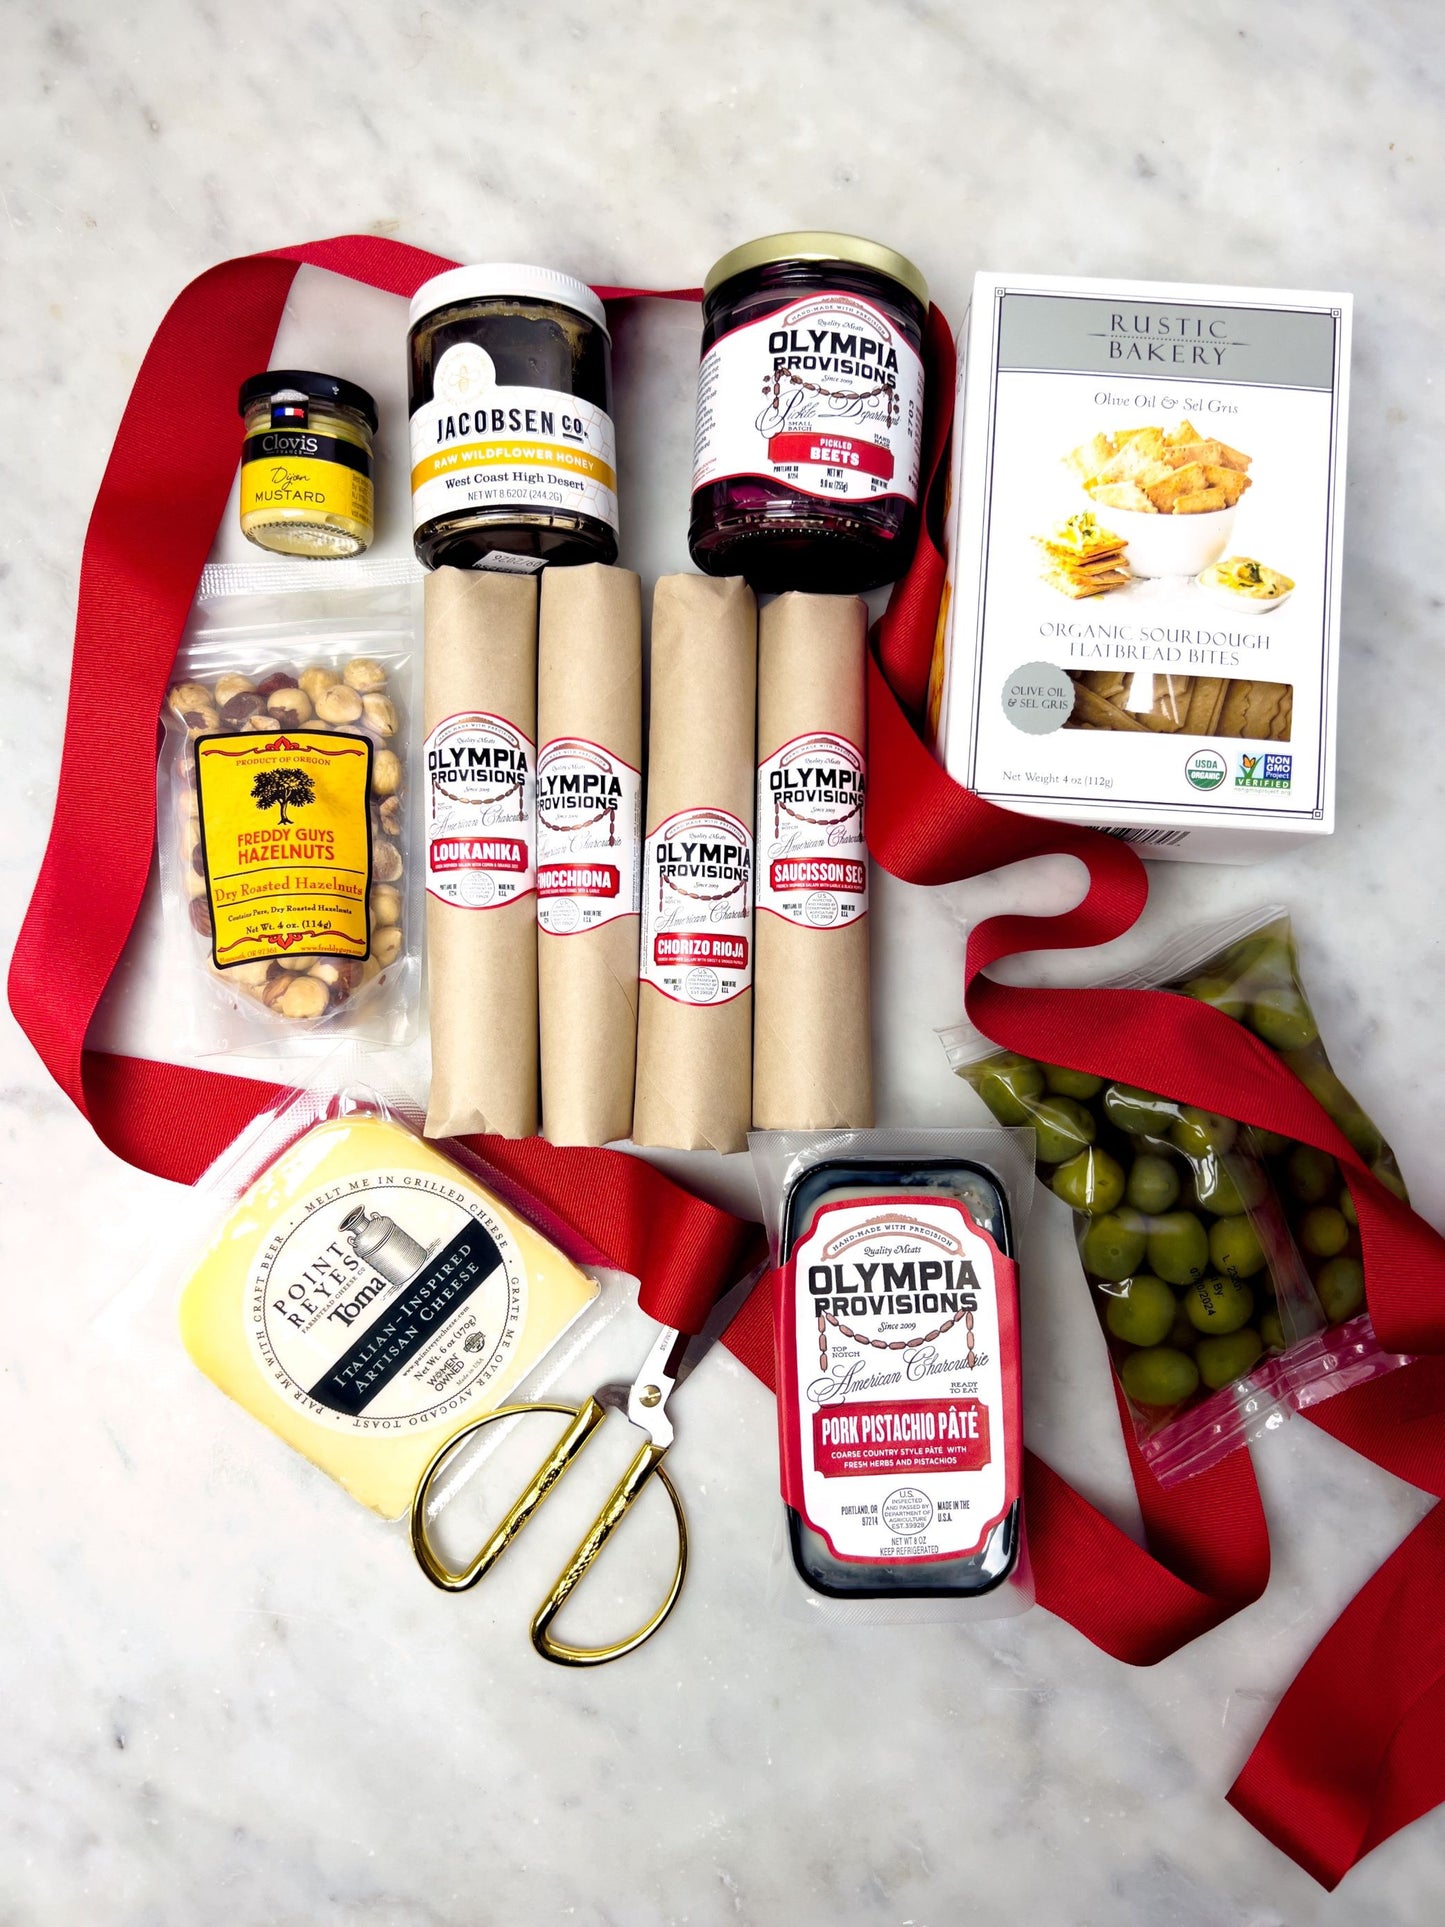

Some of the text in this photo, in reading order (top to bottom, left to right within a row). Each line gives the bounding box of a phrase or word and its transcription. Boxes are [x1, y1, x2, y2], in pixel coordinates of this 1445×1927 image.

[1110, 314, 1228, 339] RUSTIC
[768, 329, 899, 374] OLYMPIA
[1109, 341, 1227, 366] BAKERY
[773, 356, 896, 389] PROVISIONS
[818, 390, 901, 424] Departmnt
[1094, 392, 1239, 415] Olive Oil & Sel Gris
[437, 408, 588, 444] JACOBSEN CO.
[262, 435, 318, 452] Clovis
[820, 438, 853, 451] PICKLED
[434, 447, 594, 472] RAW WILDFLOWER HONEY
[810, 446, 860, 467] BEETS
[270, 466, 311, 491] Dijon
[445, 472, 585, 491] West Coast High Desert
[255, 490, 326, 504] MUSTARD
[468, 490, 482, 501] NET
[485, 490, 497, 500] WT
[1040, 622, 1270, 650] ORGANIC SOURDOUGH
[1070, 642, 1240, 667] FLATBREAD BITES
[1011, 685, 1067, 697] OLIVE OIL
[1007, 698, 1069, 711] & SEL GRIS
[236, 757, 277, 767] PRODUCT
[293, 756, 331, 766] OREGON
[428, 747, 529, 773] OLYMPIA
[1195, 760, 1218, 769] USDA
[1266, 764, 1291, 773] GMO
[1267, 756, 1290, 765] NON
[431, 769, 526, 786] PROVISIONS
[770, 767, 865, 795] OLYMPIA
[1002, 771, 1114, 788] Net Weight 4 oz (112g)
[1191, 771, 1221, 781] ORGANIC
[1238, 778, 1289, 788] VERIFIED
[774, 790, 865, 807] PROVISIONS
[238, 828, 335, 848] FREDDY GUYS
[238, 844, 335, 865] HAZELNUTS
[433, 843, 521, 862] LOUKANIKA
[656, 842, 751, 869] OLYMPIA
[659, 864, 749, 882] PROVISIONS
[774, 863, 863, 884] SAUCISSON SEC
[215, 876, 363, 902] Dry Roasted Hazelnuts
[227, 910, 252, 922] Contains
[271, 905, 285, 914] Dry
[286, 904, 316, 912] Roasted
[318, 904, 352, 915] Hazelnuts
[246, 926, 259, 934] Net
[260, 923, 275, 931] Wt.
[278, 921, 283, 929] 4
[302, 920, 332, 930] (114g)
[657, 939, 744, 958] CHORIZO RIOJA
[304, 1175, 508, 1249] MELT ME IN GRILLED CHEESE
[832, 1226, 881, 1251] HAND-MADE
[909, 1225, 952, 1247] PRECISION
[864, 1244, 922, 1257] Quality Meats
[272, 1241, 343, 1317] POINT
[808, 1260, 982, 1296] OLYMPIA
[287, 1256, 360, 1330] REYES
[327, 1277, 387, 1328] Toma
[301, 1276, 358, 1334] FARMSTEAD CHEESE
[815, 1292, 978, 1318] PROVISIONS
[253, 1235, 324, 1415] PAIR ME WITH CRAFT BEER
[332, 1244, 472, 1388] ITALIAN-INSPIRED
[355, 1262, 480, 1394] ARTISAN CHEESE
[878, 1322, 917, 1333] Since 2009
[352, 1276, 520, 1429] GRATE ME OVER AVOCADO TOAST
[414, 1314, 477, 1381] Net Wt. 6 oz (170g)
[832, 1351, 861, 1359] NOTCH
[427, 1353, 459, 1386] WOMEN
[434, 1360, 465, 1392] OWNED
[807, 1359, 902, 1408] American
[951, 1381, 979, 1389] READY
[822, 1405, 979, 1446] PORK PISTACHIO PÂTÉ
[831, 1446, 967, 1460] COARSE COUNTRY STYLE PÂTÉ WITH
[844, 1457, 958, 1469] FRESH HERBS AND PISTACHIOS
[899, 1490, 914, 1498] U.S.
[841, 1505, 878, 1516] PORTLAND, OR
[937, 1500, 970, 1510] MADE IN THE
[862, 1516, 878, 1526] 97214
[938, 1513, 953, 1522] U.S.A.
[880, 1545, 939, 1556] KEEP REFRIGERATED
[891, 1536, 927, 1546] NET WT 8 OZ
